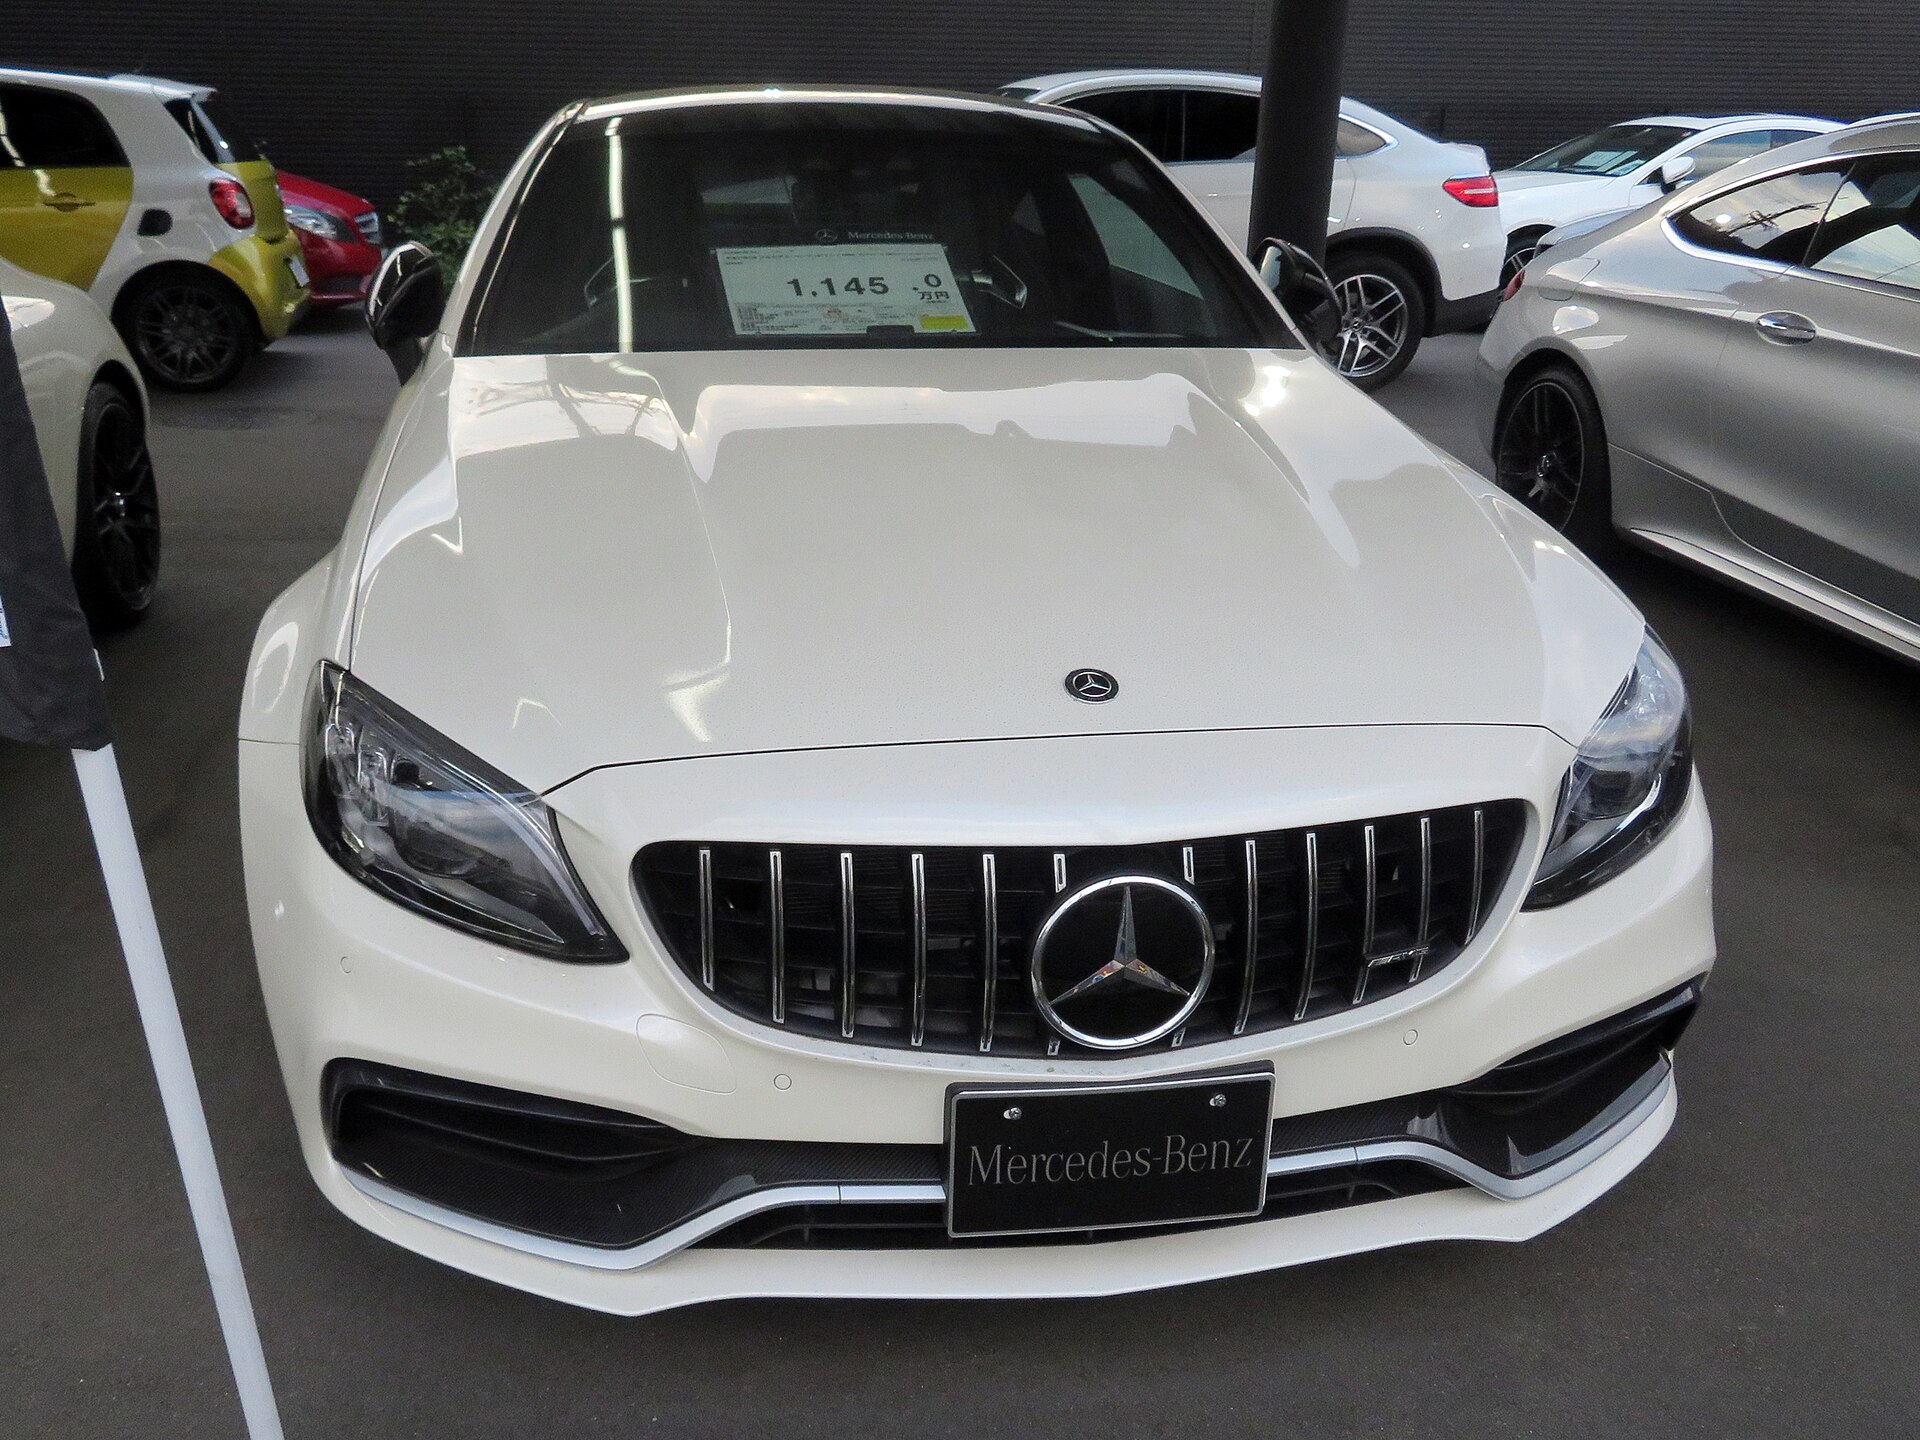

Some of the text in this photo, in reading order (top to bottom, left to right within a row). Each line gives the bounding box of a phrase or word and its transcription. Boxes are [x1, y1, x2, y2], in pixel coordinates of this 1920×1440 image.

[848, 231, 934, 240] Mercedes-Benz
[918, 291, 950, 300] 万円
[968, 1134, 1253, 1186] Mercedes-Benz
